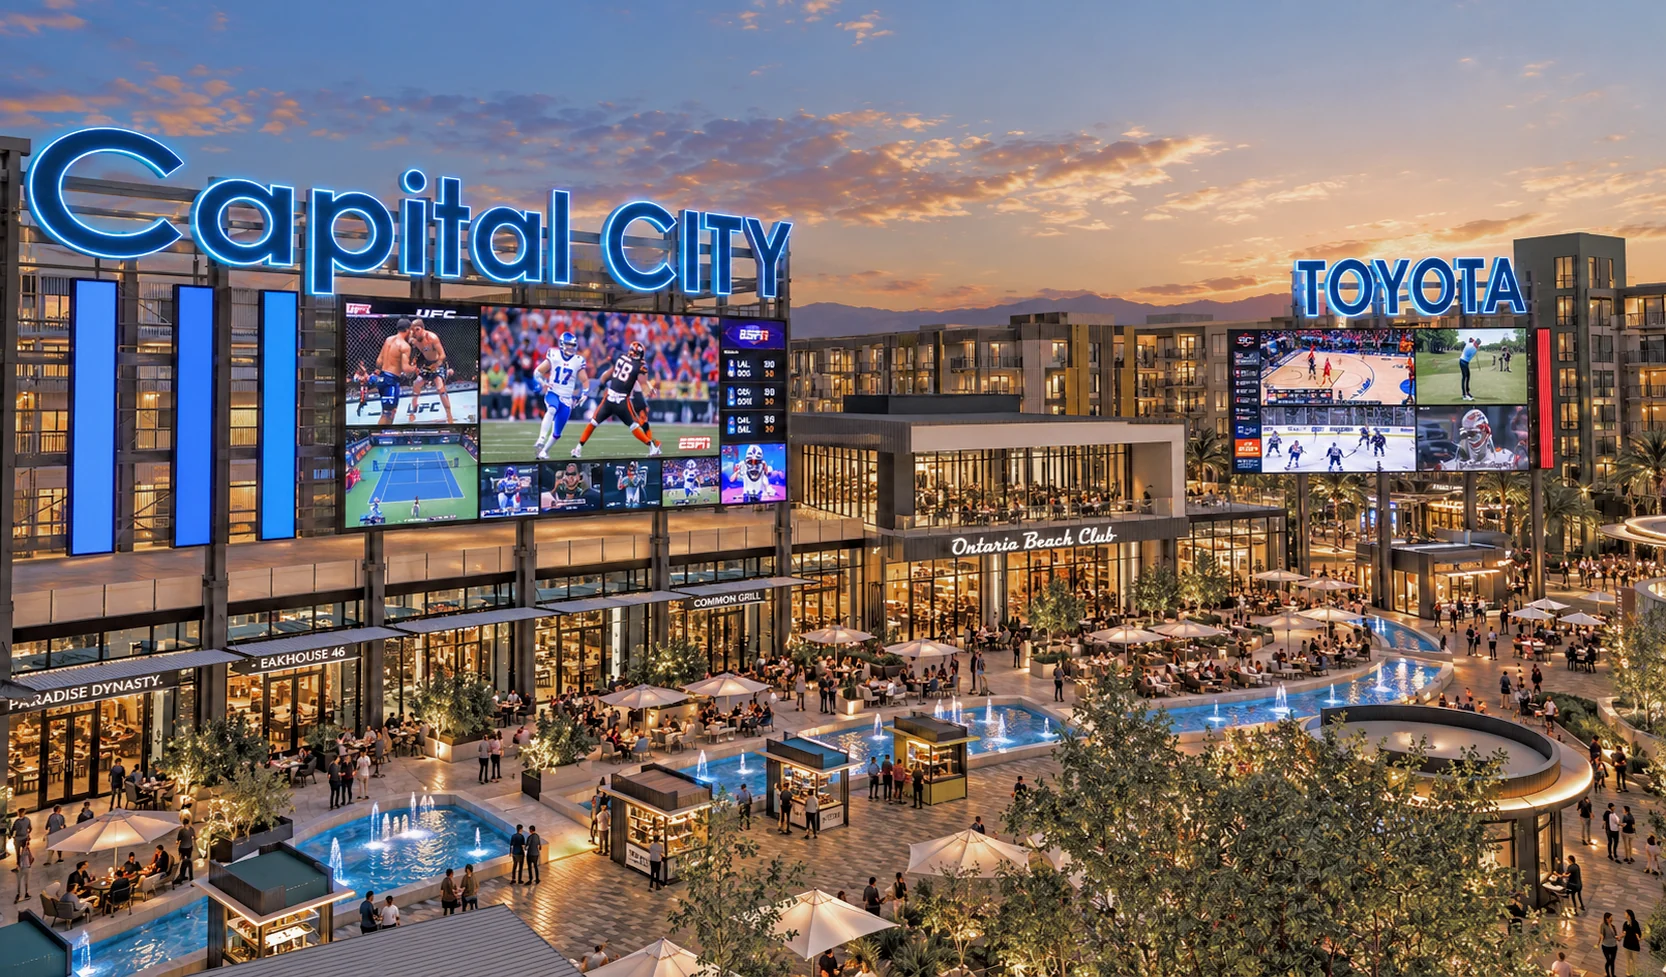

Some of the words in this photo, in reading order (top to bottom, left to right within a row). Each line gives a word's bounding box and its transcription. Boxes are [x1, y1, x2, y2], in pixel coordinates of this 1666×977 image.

[25, 127, 570, 296] Capital
[602, 200, 793, 298] CITY
[1294, 256, 1527, 317] TOYOTA
[416, 308, 457, 319] UFC
[554, 366, 574, 386] 17
[612, 358, 633, 382] 58
[679, 437, 711, 449] ESPN
[1023, 529, 1074, 549] Beach
[1078, 526, 1117, 544] Club
[693, 595, 737, 608] COMMON
[738, 591, 761, 602] GRILL
[260, 648, 329, 669] EAKHOUSE
[331, 646, 346, 658] 46
